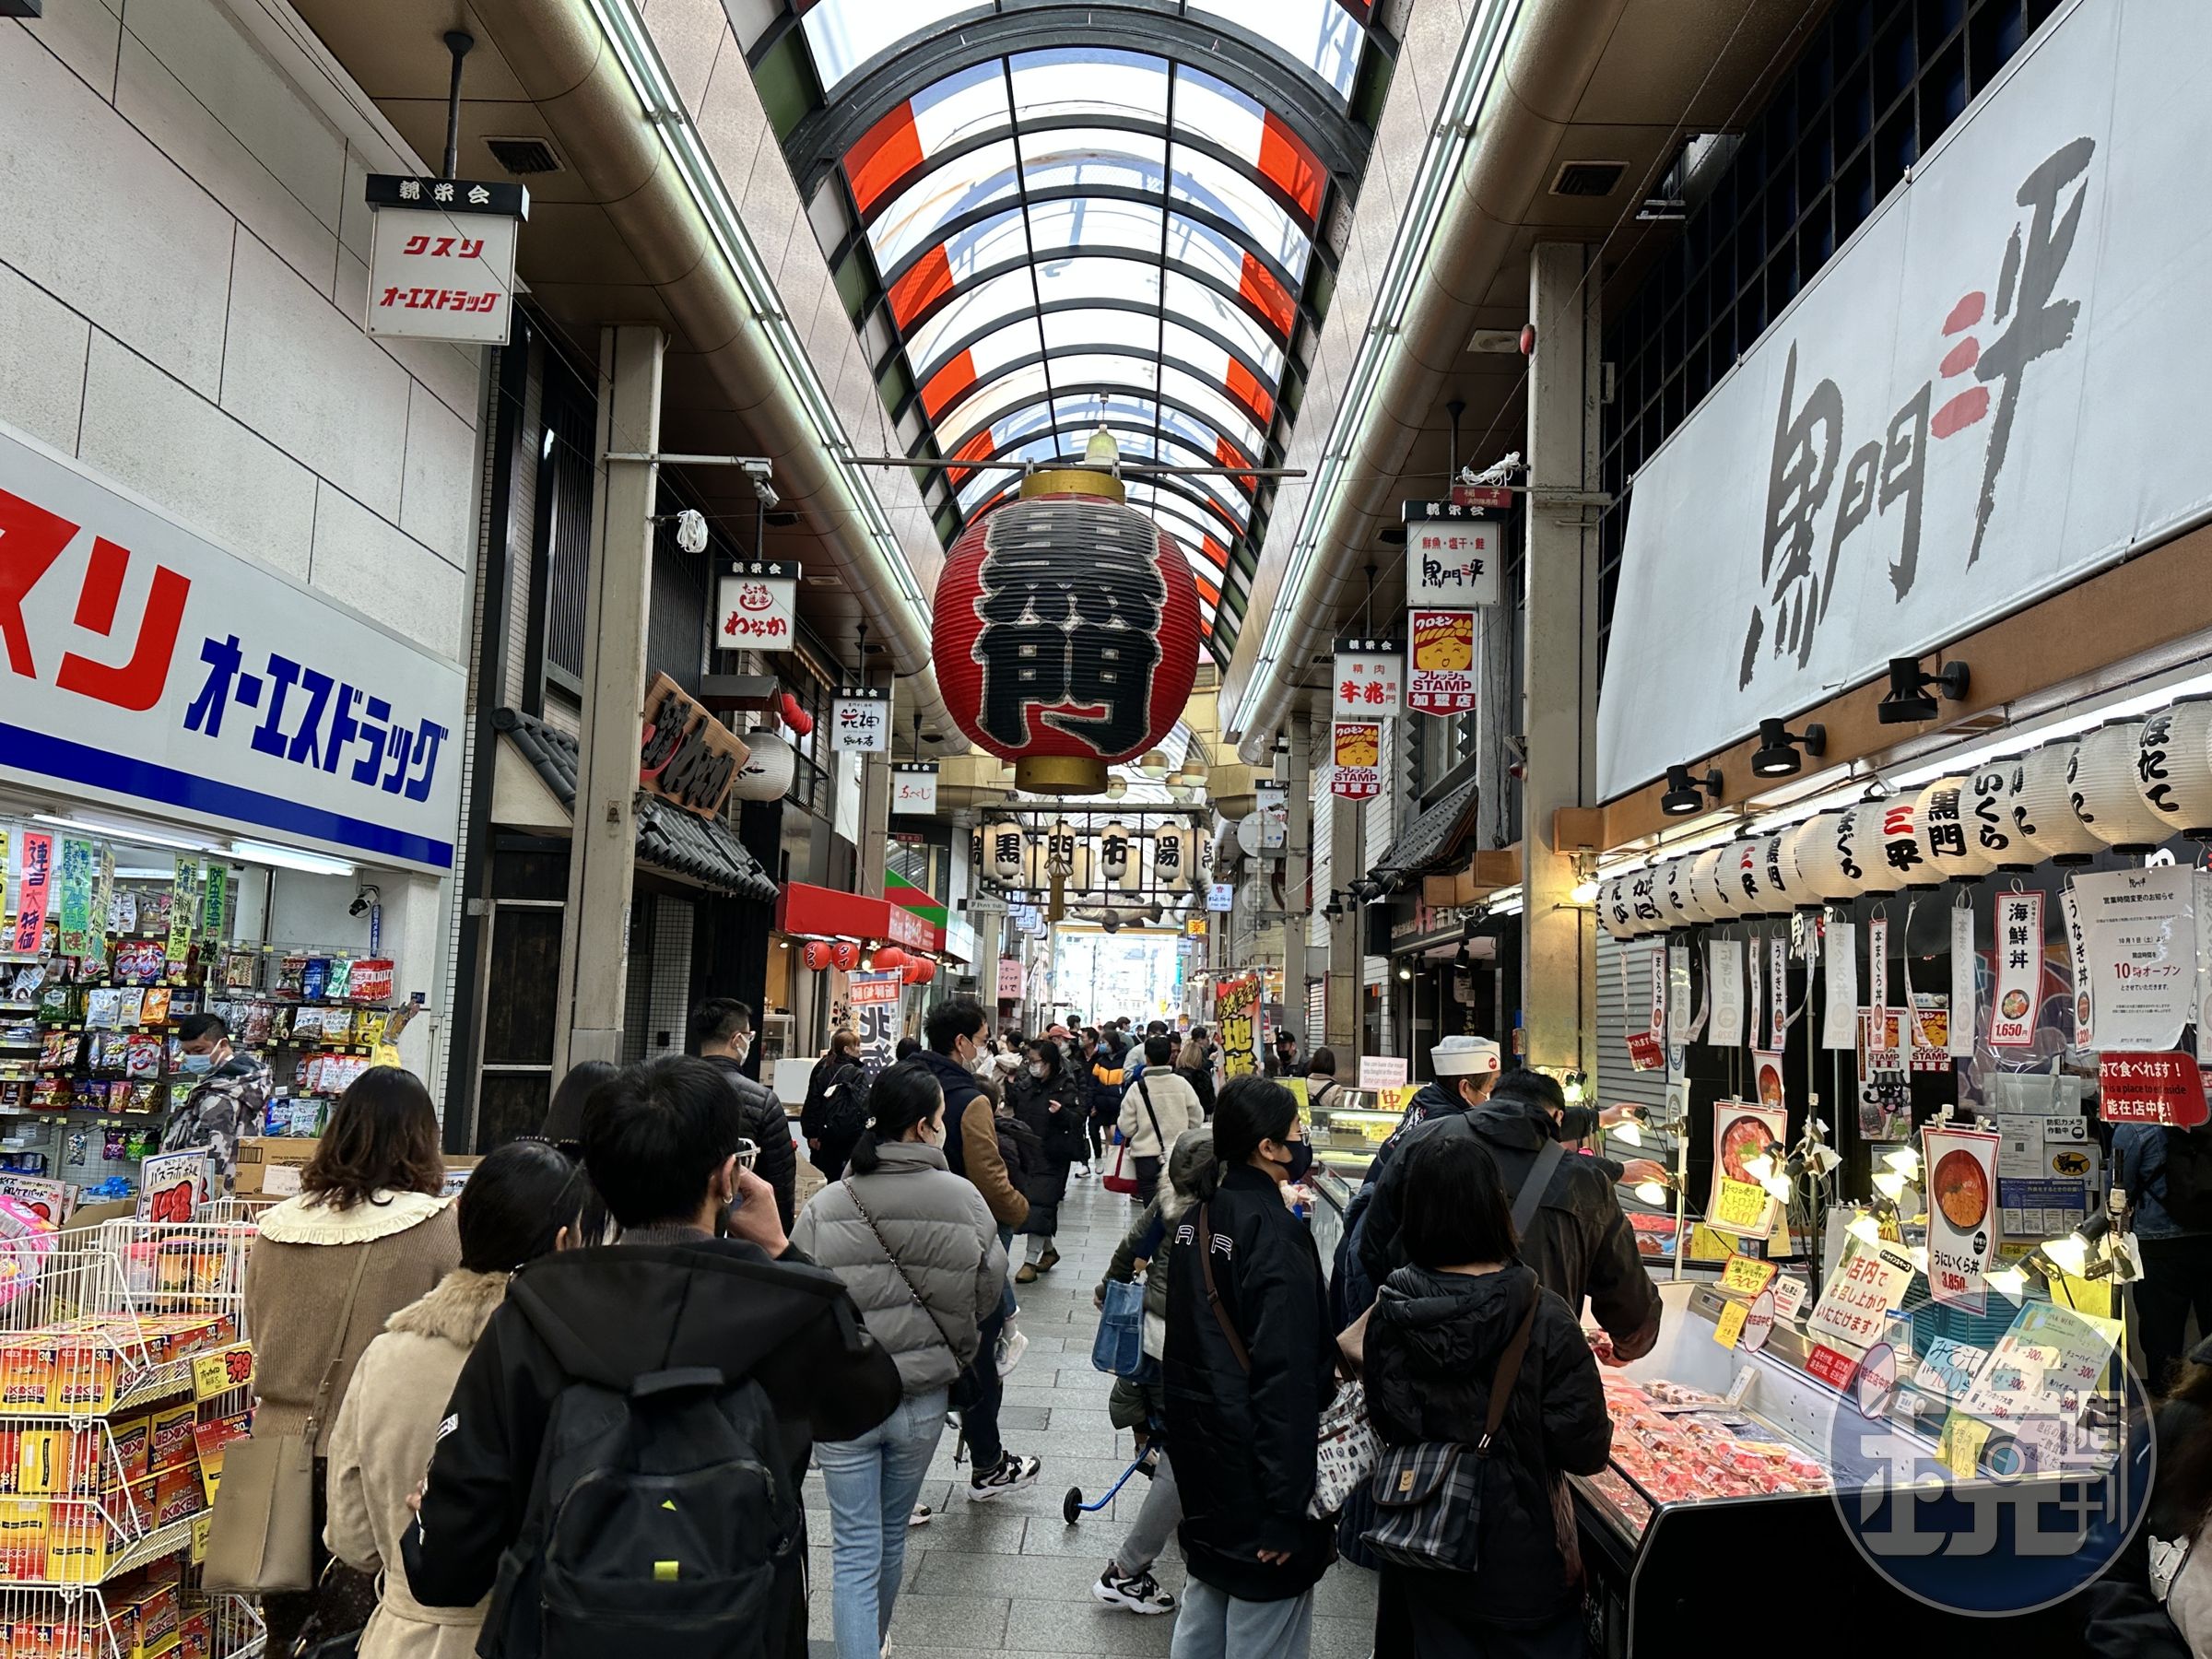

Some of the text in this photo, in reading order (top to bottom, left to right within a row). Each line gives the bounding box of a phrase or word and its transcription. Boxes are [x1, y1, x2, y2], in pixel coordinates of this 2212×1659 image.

[399, 181, 490, 205] 親栄会
[403, 236, 485, 259] クスリ
[380, 287, 500, 313] オーエスドラッグ
[724, 611, 787, 638] わなか
[1415, 615, 1453, 629] クロモン
[1352, 664, 1385, 676] 精肉
[1418, 670, 1465, 681] フレッシュ
[1413, 680, 1472, 692] STAMP
[1412, 693, 1472, 708] 加盟店
[182, 633, 449, 803] オーエスドラッグ
[1336, 725, 1364, 736] クロモン
[1338, 766, 1373, 774] フレッシュ
[2137, 715, 2180, 812] ほたて
[1334, 772, 1378, 782] STAMP
[1334, 783, 1377, 794] 加盟店
[1927, 787, 1967, 857] 黒門
[1974, 772, 2009, 850] いくら
[995, 834, 1180, 867] 黒門市場
[1837, 811, 1863, 879] まぐろ
[18, 840, 48, 950] 連日大特価
[2103, 892, 2174, 904] 営業時間変更のお知らせ
[2008, 902, 2029, 969] 海鮮丼
[2069, 899, 2088, 987] うなぎ丼
[839, 946, 851, 967] タイ
[1875, 930, 1885, 1002] 本まぐろ丼
[1912, 1053, 1949, 1061] STAMP
[1912, 1062, 1949, 1071] 加盟店
[2123, 1083, 2144, 1096] place
[2145, 1084, 2153, 1093] to
[150, 1179, 194, 1222] 198
[1846, 1255, 1889, 1287] 店内で
[1935, 1250, 1980, 1277] うにいくら丼
[1830, 1282, 1888, 1312] お召し上がり
[1816, 1304, 1880, 1337] いただけます！
[1930, 1340, 1980, 1372] みそ汁
